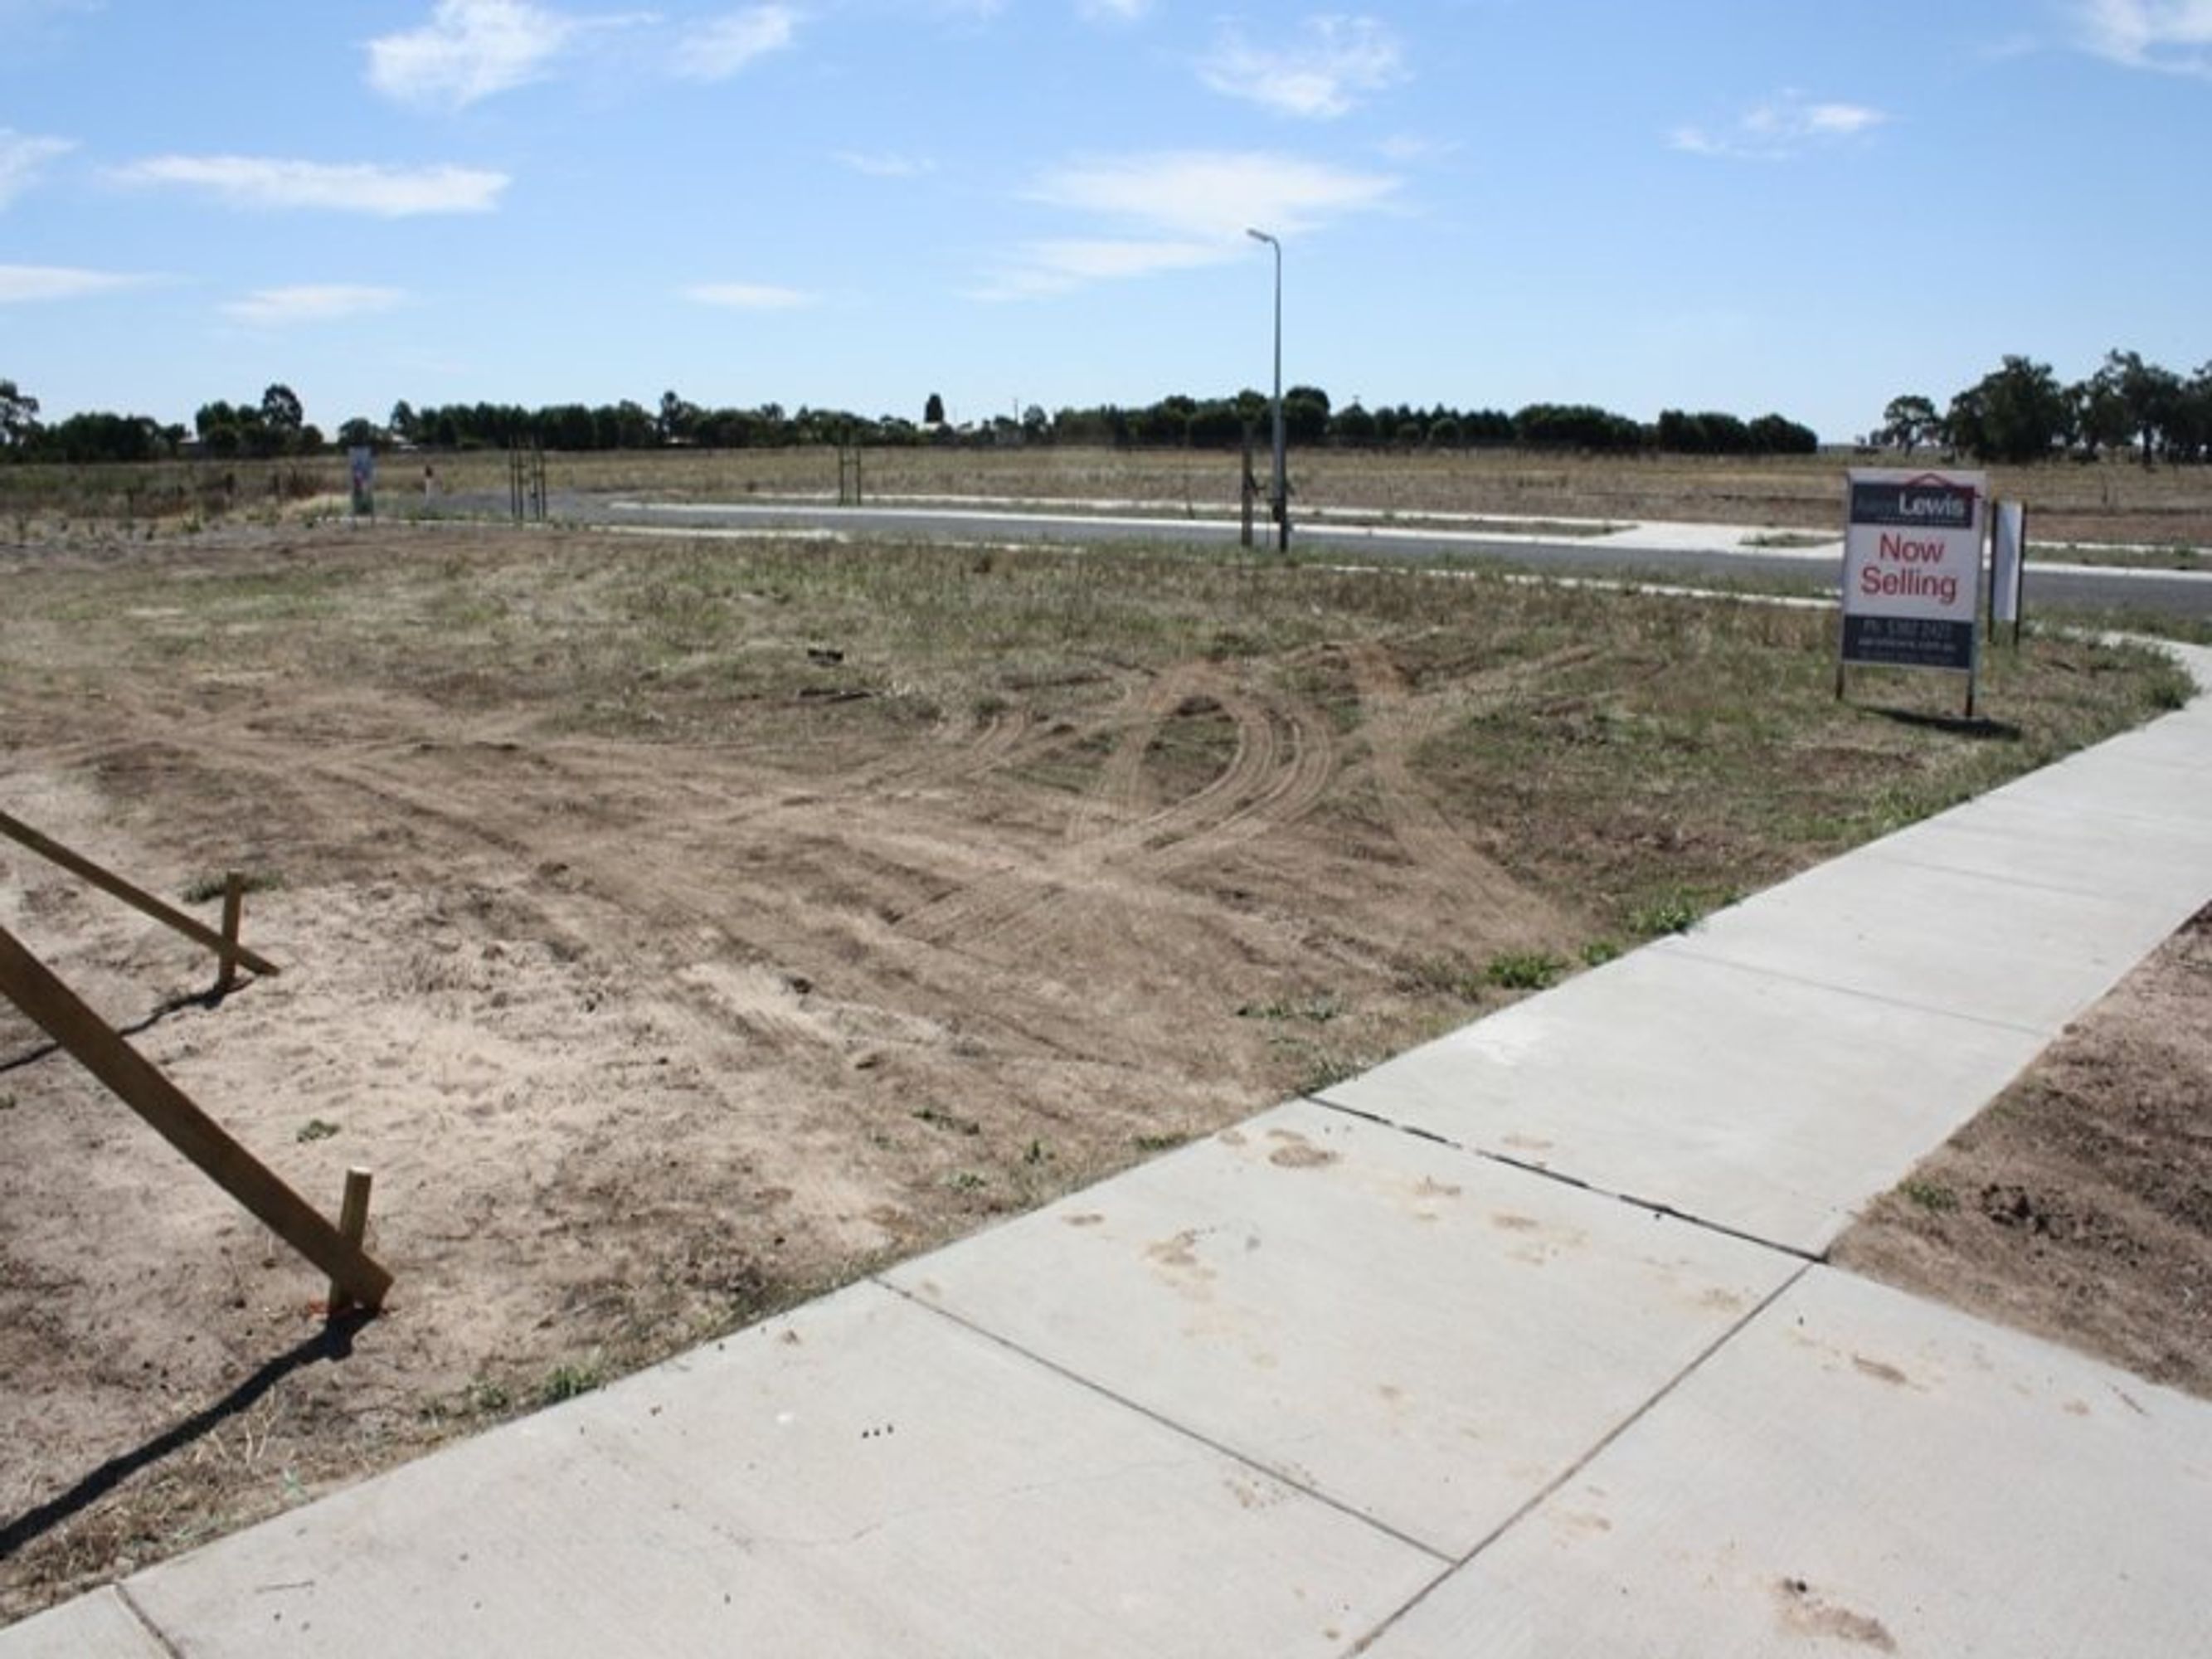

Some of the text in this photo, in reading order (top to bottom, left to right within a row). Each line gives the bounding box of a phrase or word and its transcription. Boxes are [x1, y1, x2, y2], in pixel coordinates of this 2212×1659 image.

[1898, 492, 1964, 516] Lewis
[1879, 534, 1945, 563] Now
[1861, 567, 1958, 606] Selling
